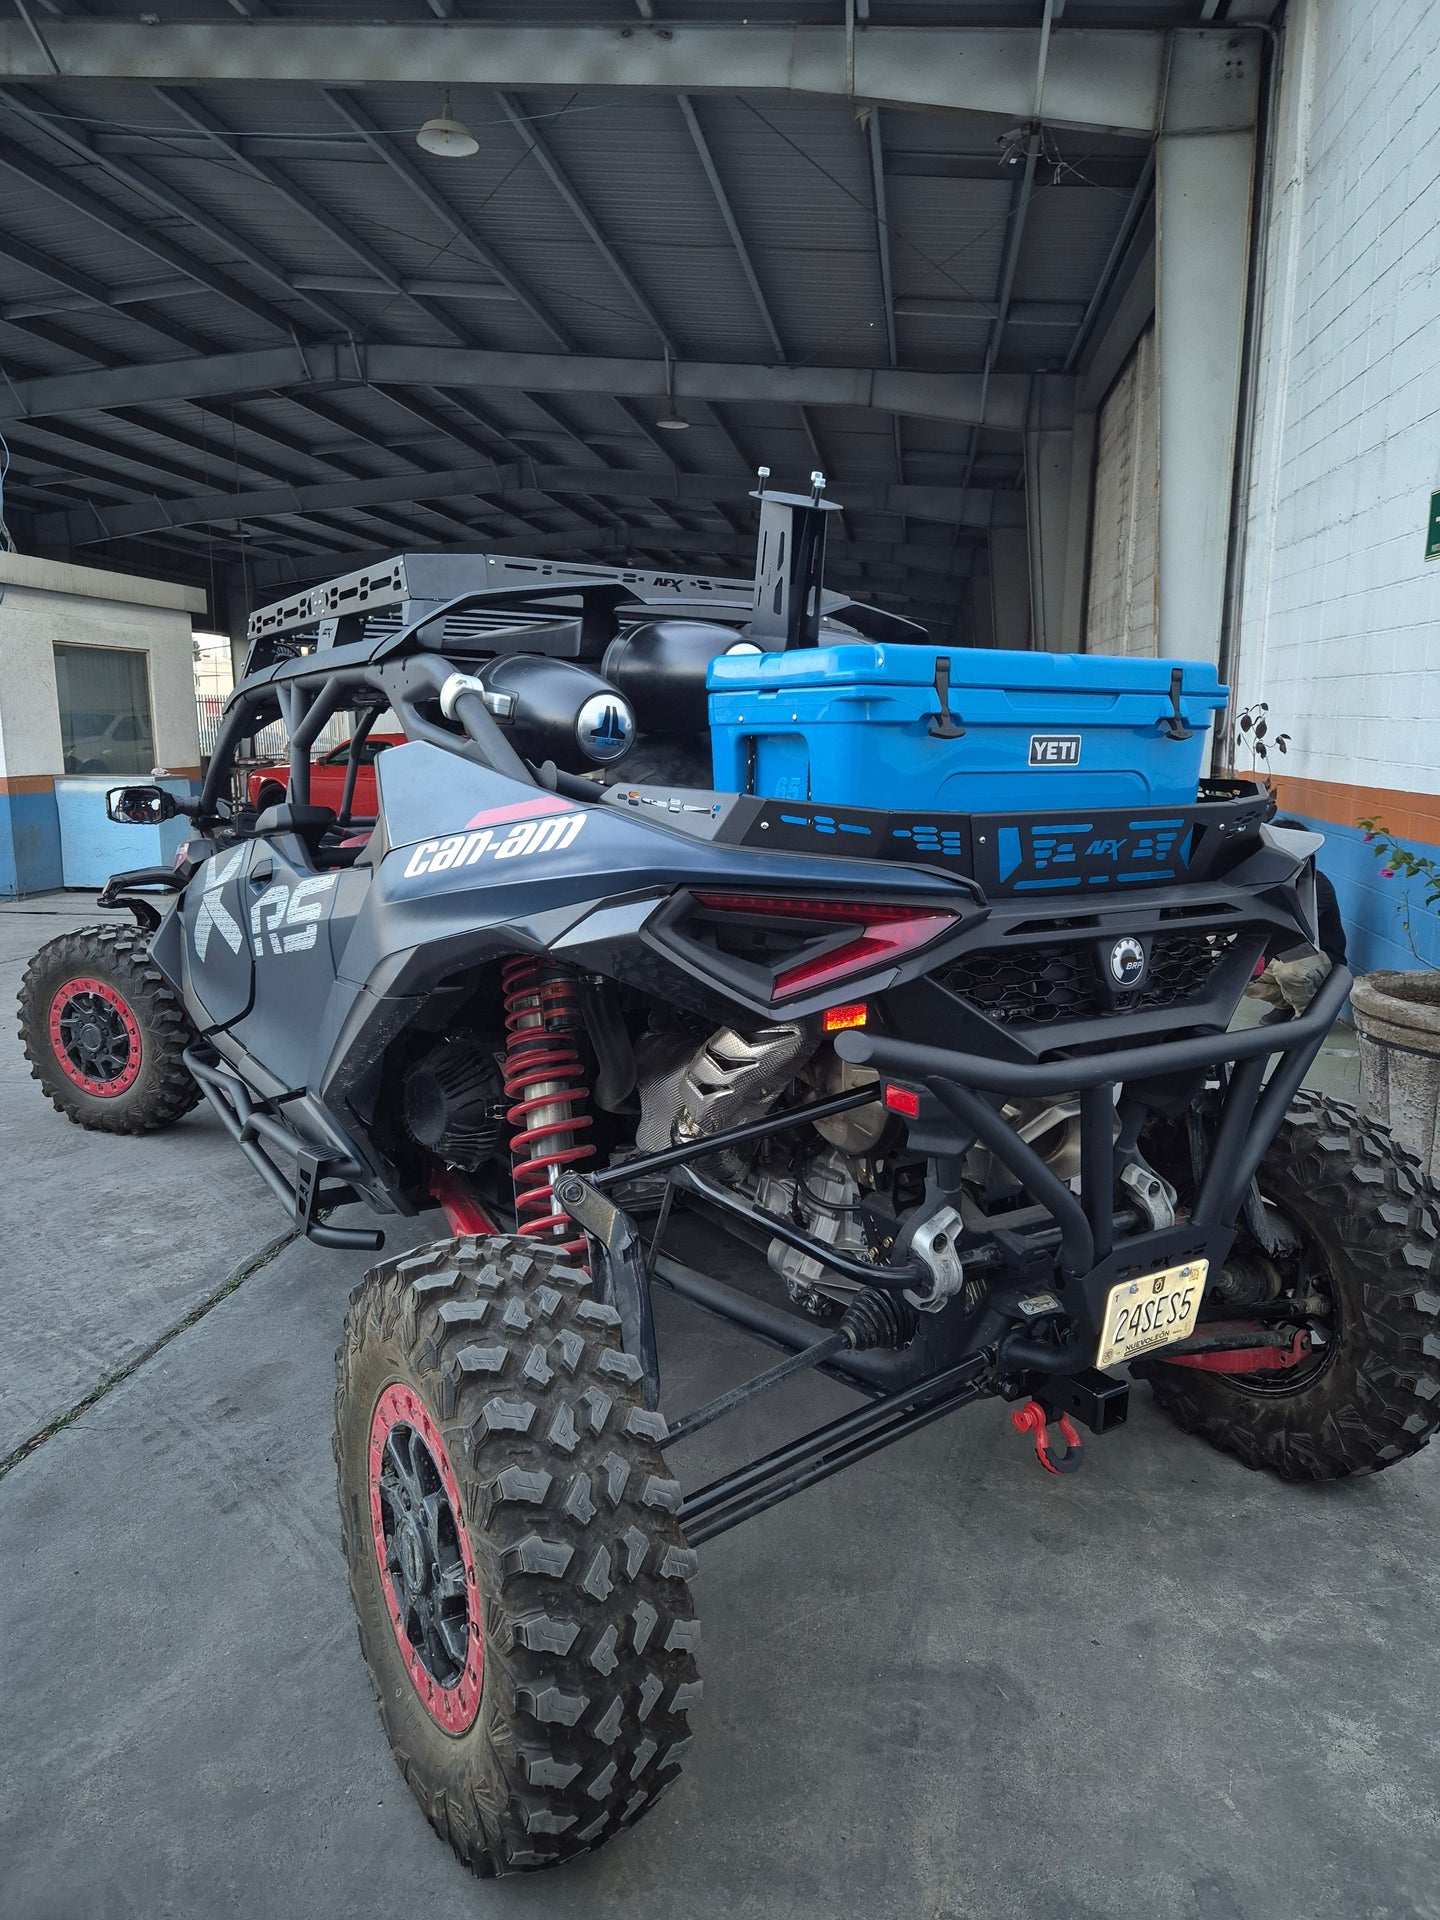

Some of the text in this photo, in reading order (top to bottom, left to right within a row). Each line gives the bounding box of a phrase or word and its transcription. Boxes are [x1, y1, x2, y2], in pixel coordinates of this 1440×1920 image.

[1034, 741, 1077, 760] YETI
[775, 776, 800, 800] 65
[404, 814, 587, 878] can-am
[1126, 961, 1143, 970] BRP
[1112, 1286, 1195, 1345] 24SES5
